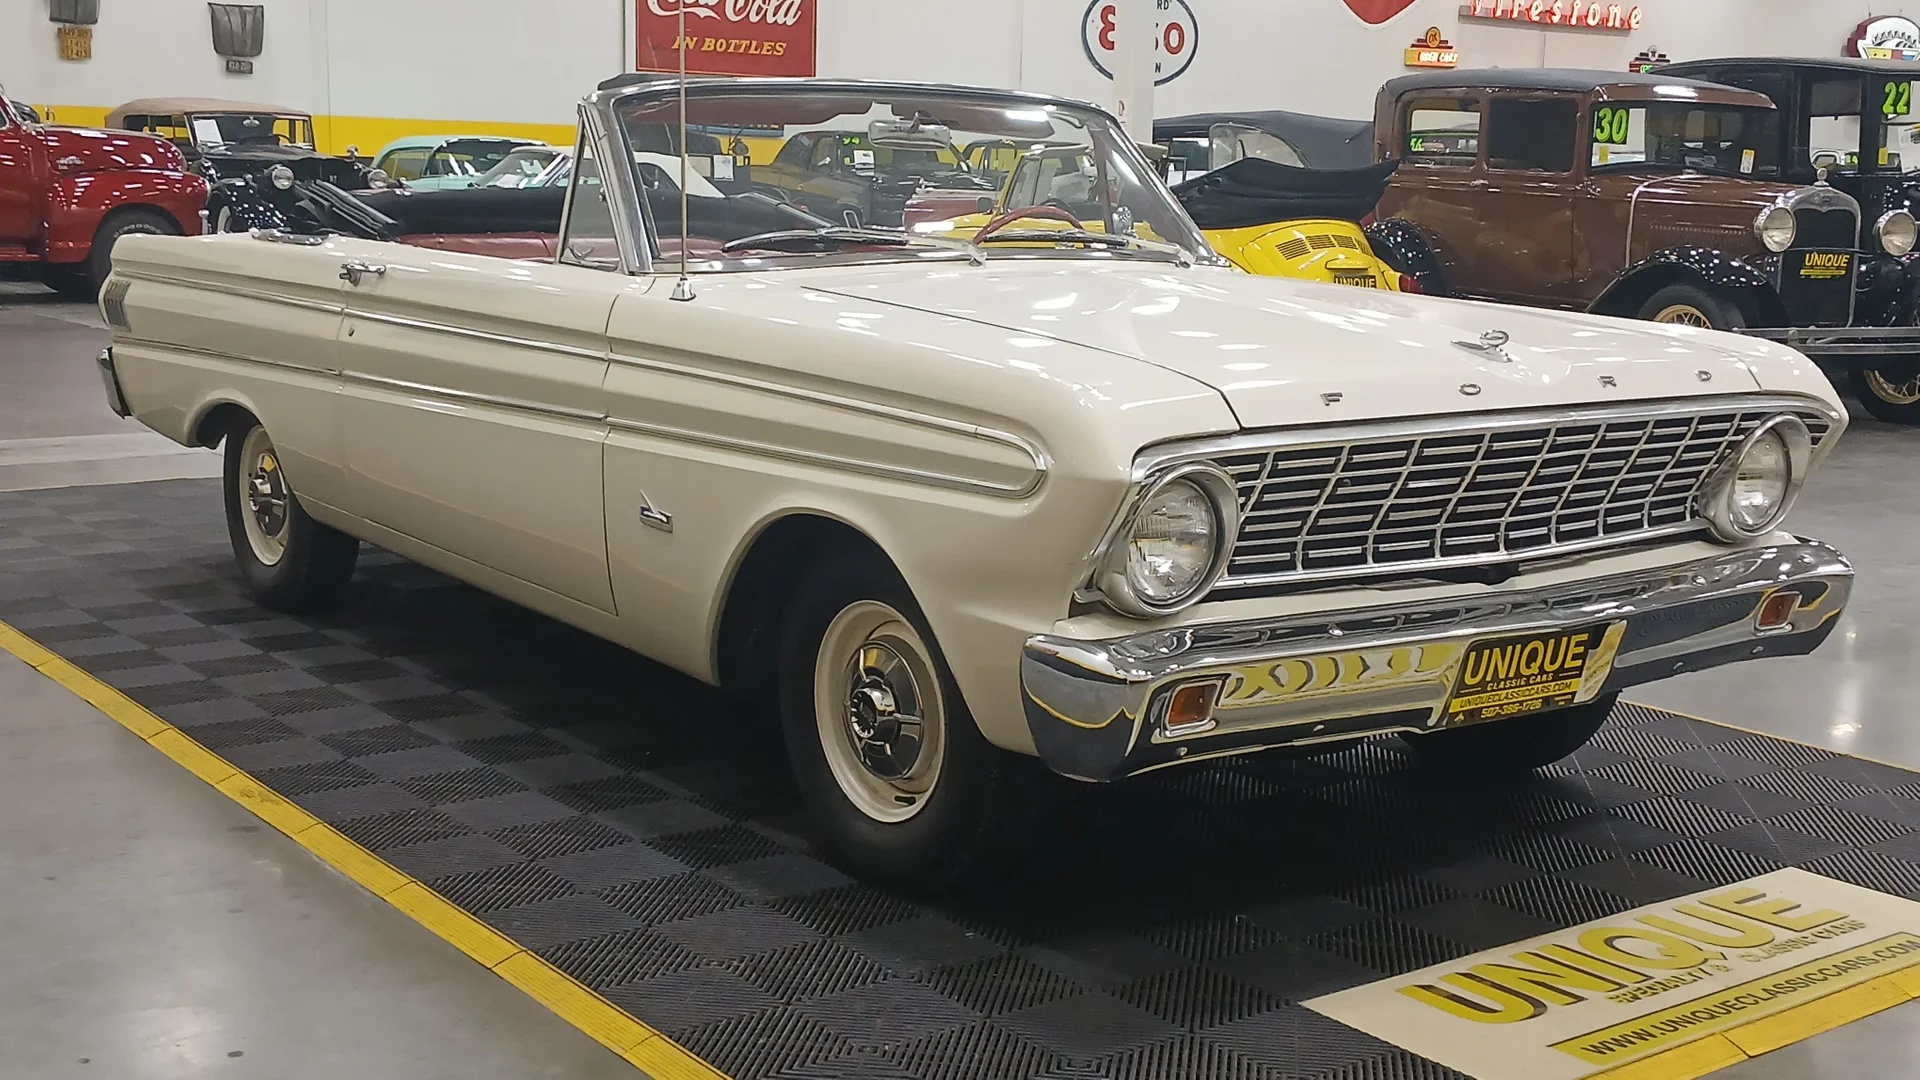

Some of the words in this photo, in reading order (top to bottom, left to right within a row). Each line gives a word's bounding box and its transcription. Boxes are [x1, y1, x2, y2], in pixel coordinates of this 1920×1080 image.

[671, 36, 698, 50] IN
[701, 38, 787, 56] BOTTLES
[1882, 82, 1911, 114] 22
[1596, 107, 1628, 143] 30
[1805, 252, 1850, 267] UNIQUE
[1464, 633, 1590, 685] UNIQUE
[1486, 677, 1527, 691] CLASSIC
[1529, 672, 1554, 684] CARS
[1395, 887, 1850, 1024] UNIQUE
[1580, 939, 1920, 1055] WWW.UNIQUECLASSICCARS.COM
